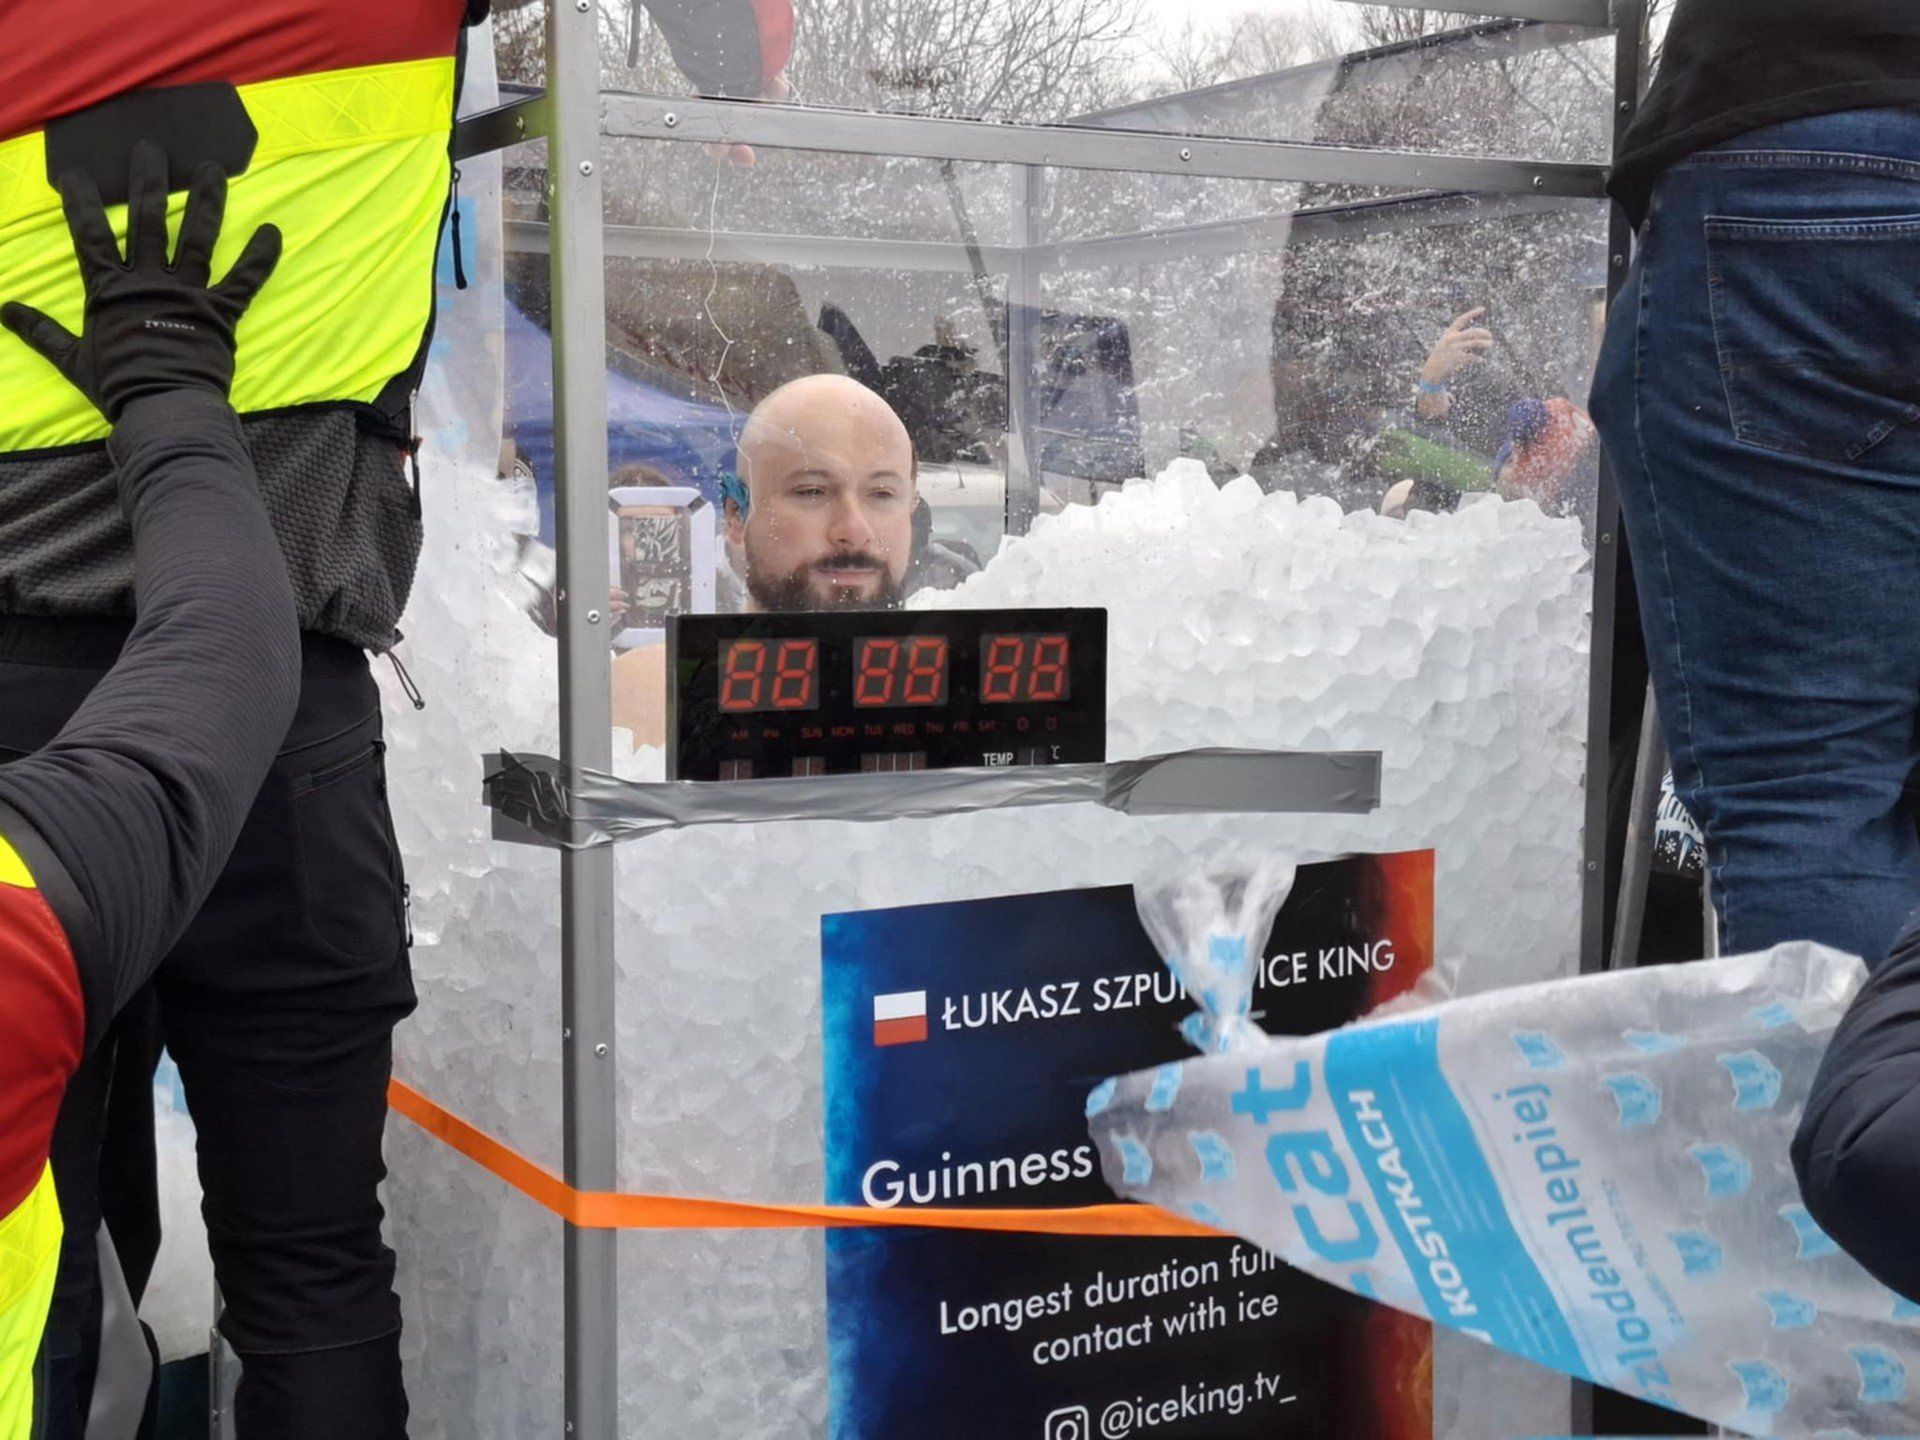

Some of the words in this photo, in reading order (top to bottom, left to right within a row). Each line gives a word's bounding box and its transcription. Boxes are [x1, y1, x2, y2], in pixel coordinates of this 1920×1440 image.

[983, 752, 1014, 766] TEMP
[941, 981, 1081, 1030] ŁUKASZ
[1093, 970, 1186, 1011] SZPU
[1259, 952, 1308, 989] ICE
[1319, 939, 1395, 980] KING
[862, 1145, 1094, 1209] Guinness
[1348, 1090, 1478, 1316] KOSTKACH
[940, 1282, 1073, 1334] Longest
[1084, 1258, 1219, 1308] duration
[1229, 1244, 1276, 1278] full
[1032, 1315, 1153, 1365] contact
[1163, 1296, 1226, 1337] with
[1238, 1290, 1279, 1322] ice
[1100, 1371, 1297, 1440] @iceking.tv_
